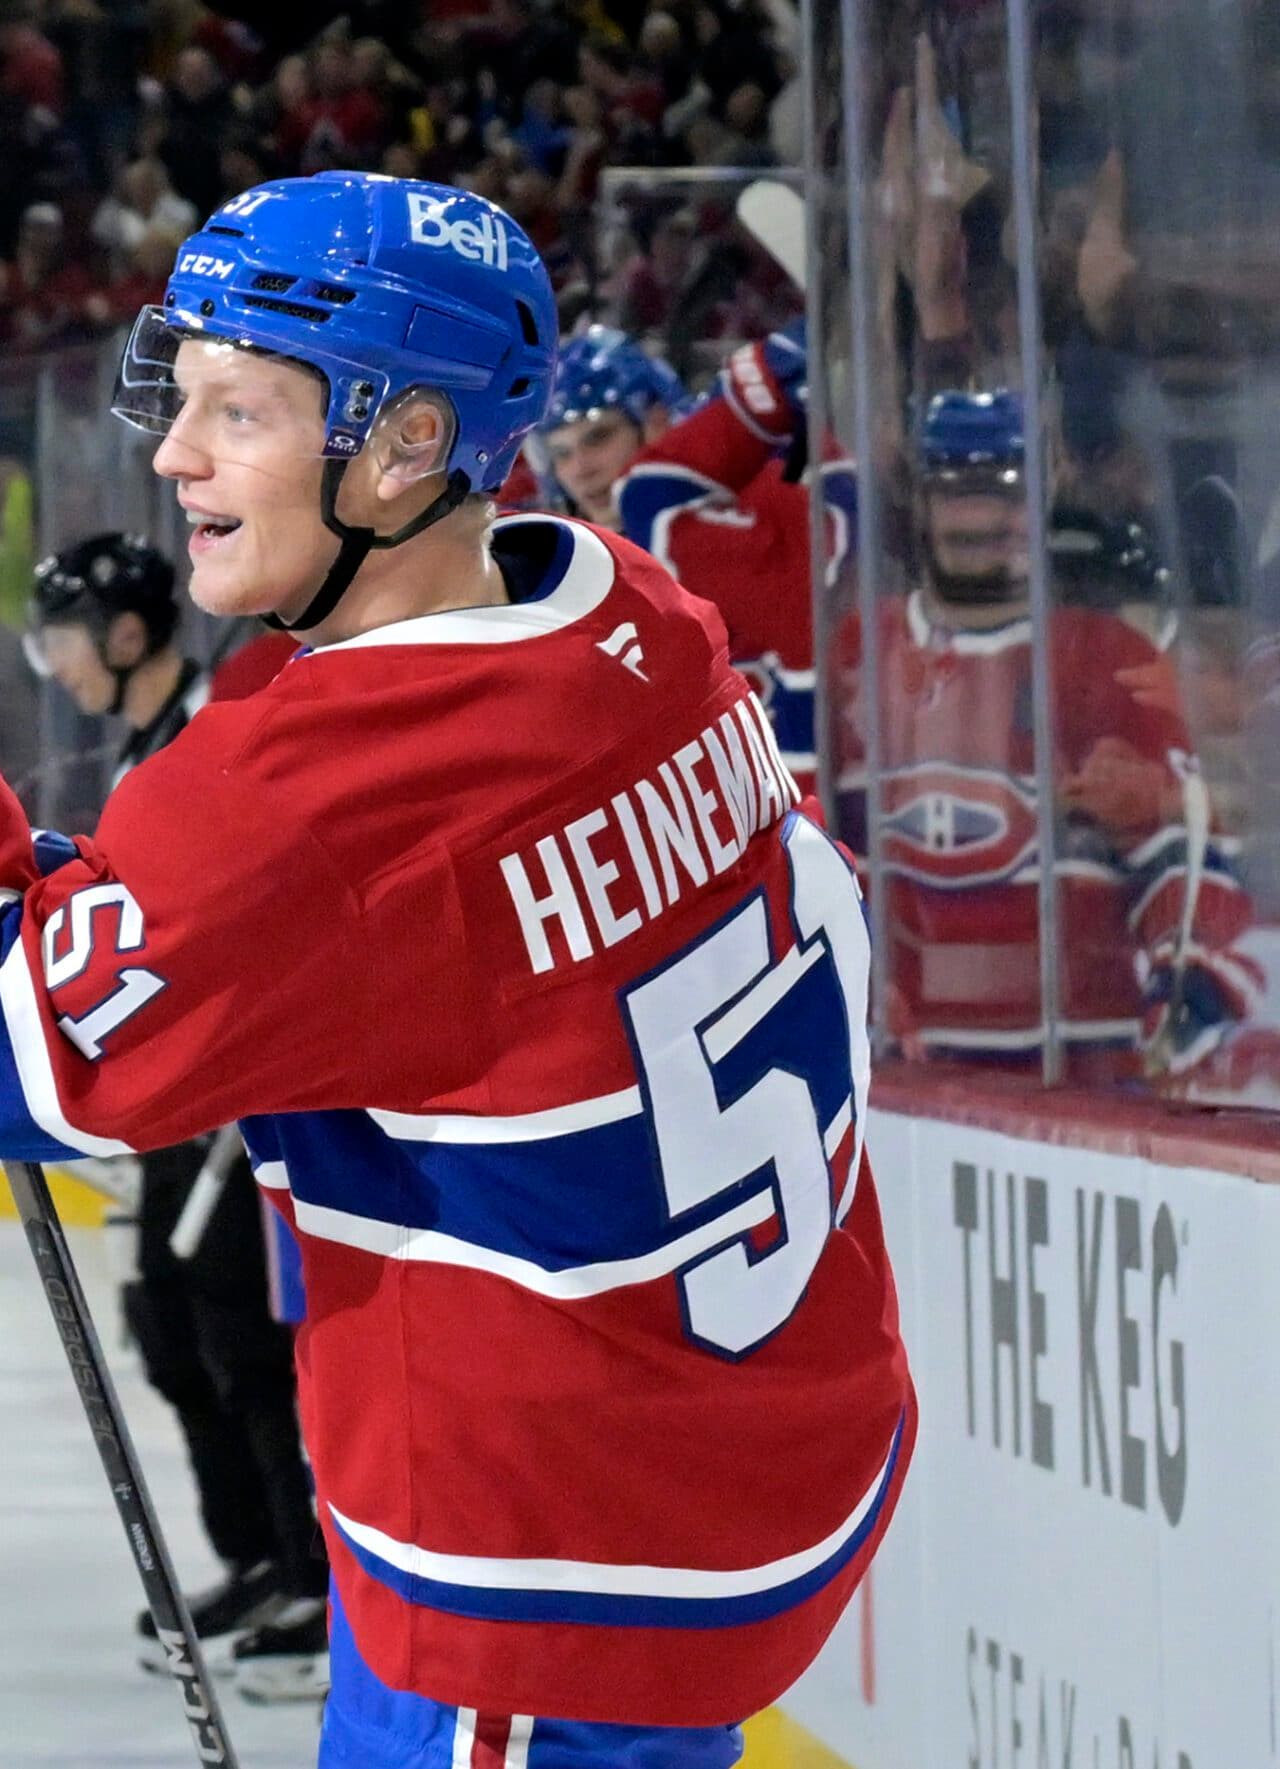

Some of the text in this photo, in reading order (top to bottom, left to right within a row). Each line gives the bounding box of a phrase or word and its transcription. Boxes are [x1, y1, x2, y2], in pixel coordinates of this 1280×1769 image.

[179, 253, 235, 279] CCM
[405, 193, 508, 272] Bell
[499, 690, 802, 975] HEINEMAN
[41, 880, 170, 1063] 51
[615, 809, 872, 1364] 51
[951, 1160, 1187, 1529] THE KEG
[157, 1628, 225, 1764] CCM
